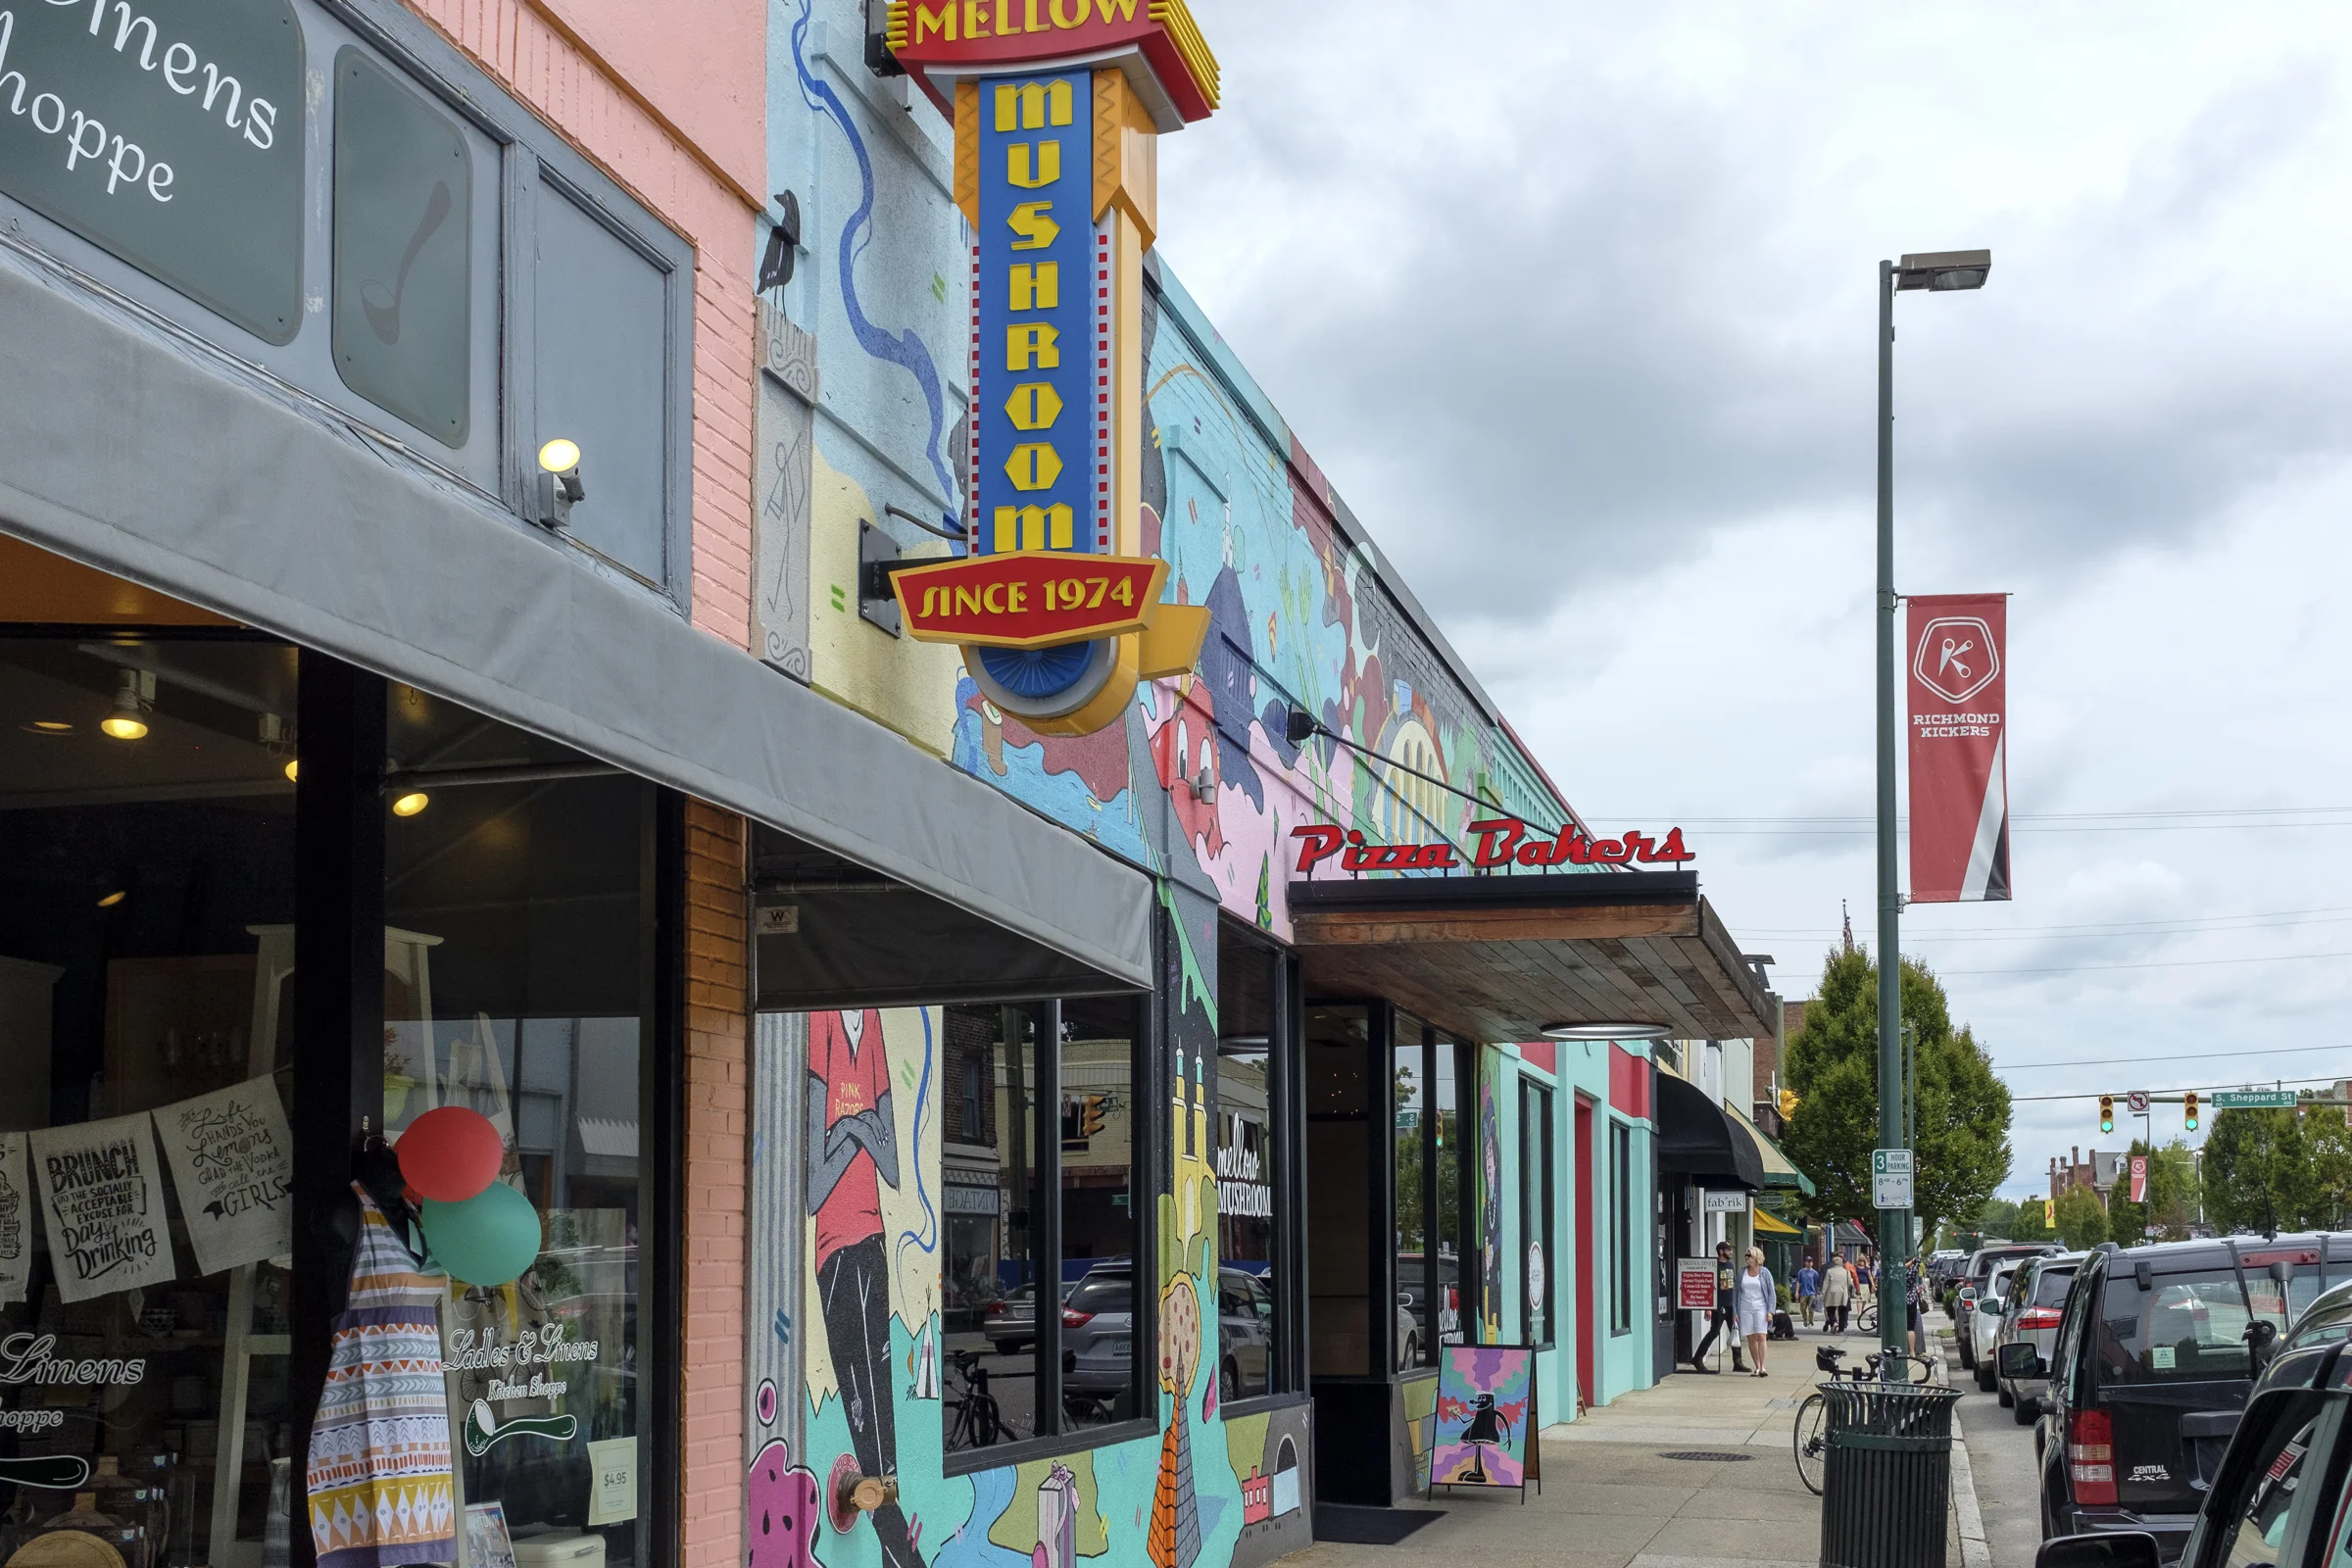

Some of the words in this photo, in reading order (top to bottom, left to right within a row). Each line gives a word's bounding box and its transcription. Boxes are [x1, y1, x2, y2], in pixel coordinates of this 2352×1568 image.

[915, 0, 1138, 45] MELLOW
[44, 0, 277, 149] inens
[917, 580, 1029, 618] SINCE
[1043, 575, 1135, 612] 1974
[1913, 712, 2000, 725] RICHMOND
[1921, 726, 1990, 738] KICKERS
[1290, 824, 1459, 872] Pizza
[1467, 818, 1696, 868] Bakers
[840, 1082, 861, 1100] PINK
[2215, 1094, 2226, 1102] S.
[2230, 1093, 2277, 1103] Sheppard
[2280, 1092, 2292, 1101] St
[206, 1123, 244, 1145] HANDS
[1217, 1111, 1260, 1181] mellow
[45, 1142, 140, 1194] BRUNCH
[198, 1166, 226, 1186] GRAB
[1877, 1155, 1886, 1170] 3
[70, 1191, 133, 1214] ACCEPTABLE
[71, 1190, 87, 1201] THE
[89, 1181, 133, 1197] SOCIALLY
[223, 1175, 287, 1217] GIRLS
[1216, 1180, 1272, 1217] MUSHROOM
[75, 1208, 114, 1225] EXCUSE
[115, 1203, 134, 1216] FOR
[61, 1220, 105, 1252] Day
[64, 1225, 158, 1280] Drinking
[0, 1332, 146, 1385] Linens
[442, 1327, 510, 1370] Ladles
[515, 1330, 537, 1365] &
[533, 1323, 599, 1363] Linens
[487, 1379, 527, 1401] Kitchen
[529, 1372, 567, 1400] Shoppe
[0, 1409, 64, 1434] oppe
[604, 1471, 627, 1490] $4.95
[2133, 1465, 2167, 1474] CENTRAL
